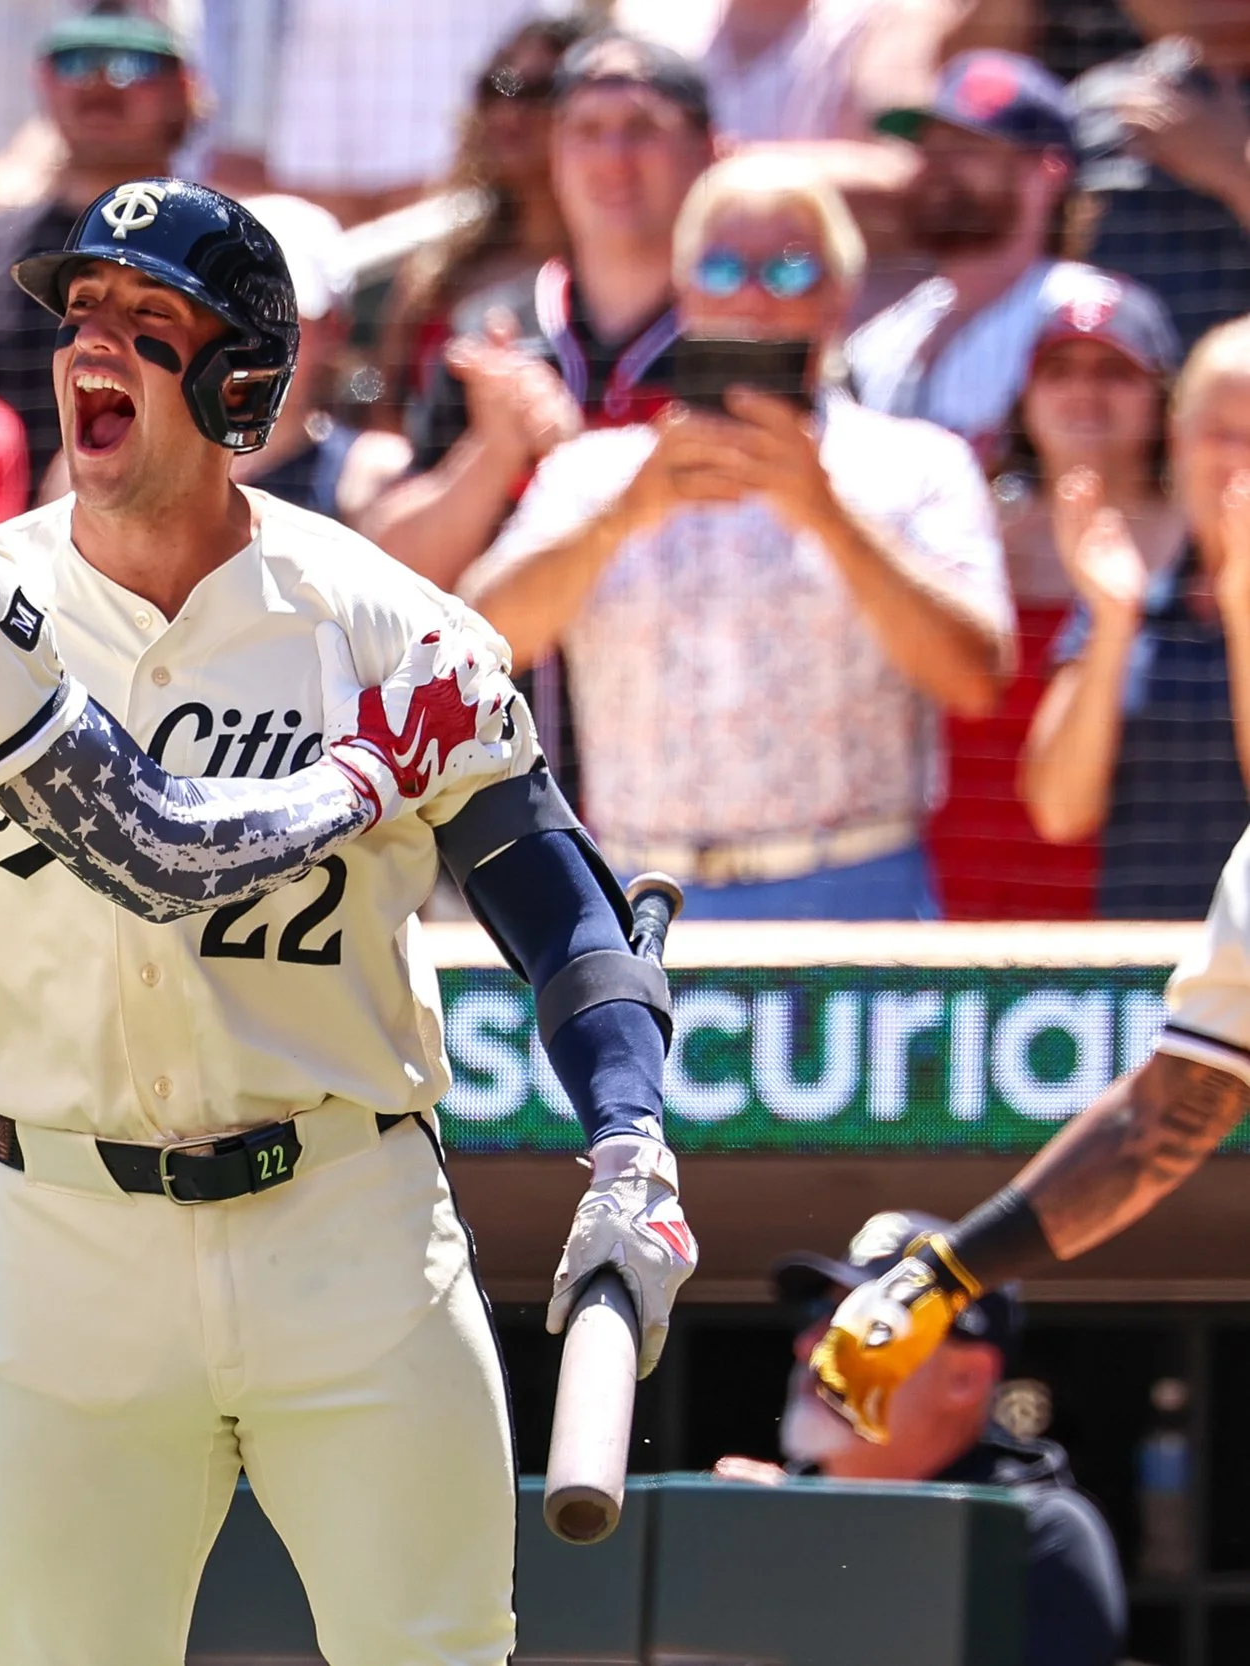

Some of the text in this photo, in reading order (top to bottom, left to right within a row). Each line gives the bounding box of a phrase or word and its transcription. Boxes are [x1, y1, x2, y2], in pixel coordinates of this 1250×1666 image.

[10, 602, 37, 639] M
[147, 702, 325, 780] Citie
[200, 854, 347, 965] 22
[257, 1145, 288, 1180] 22
